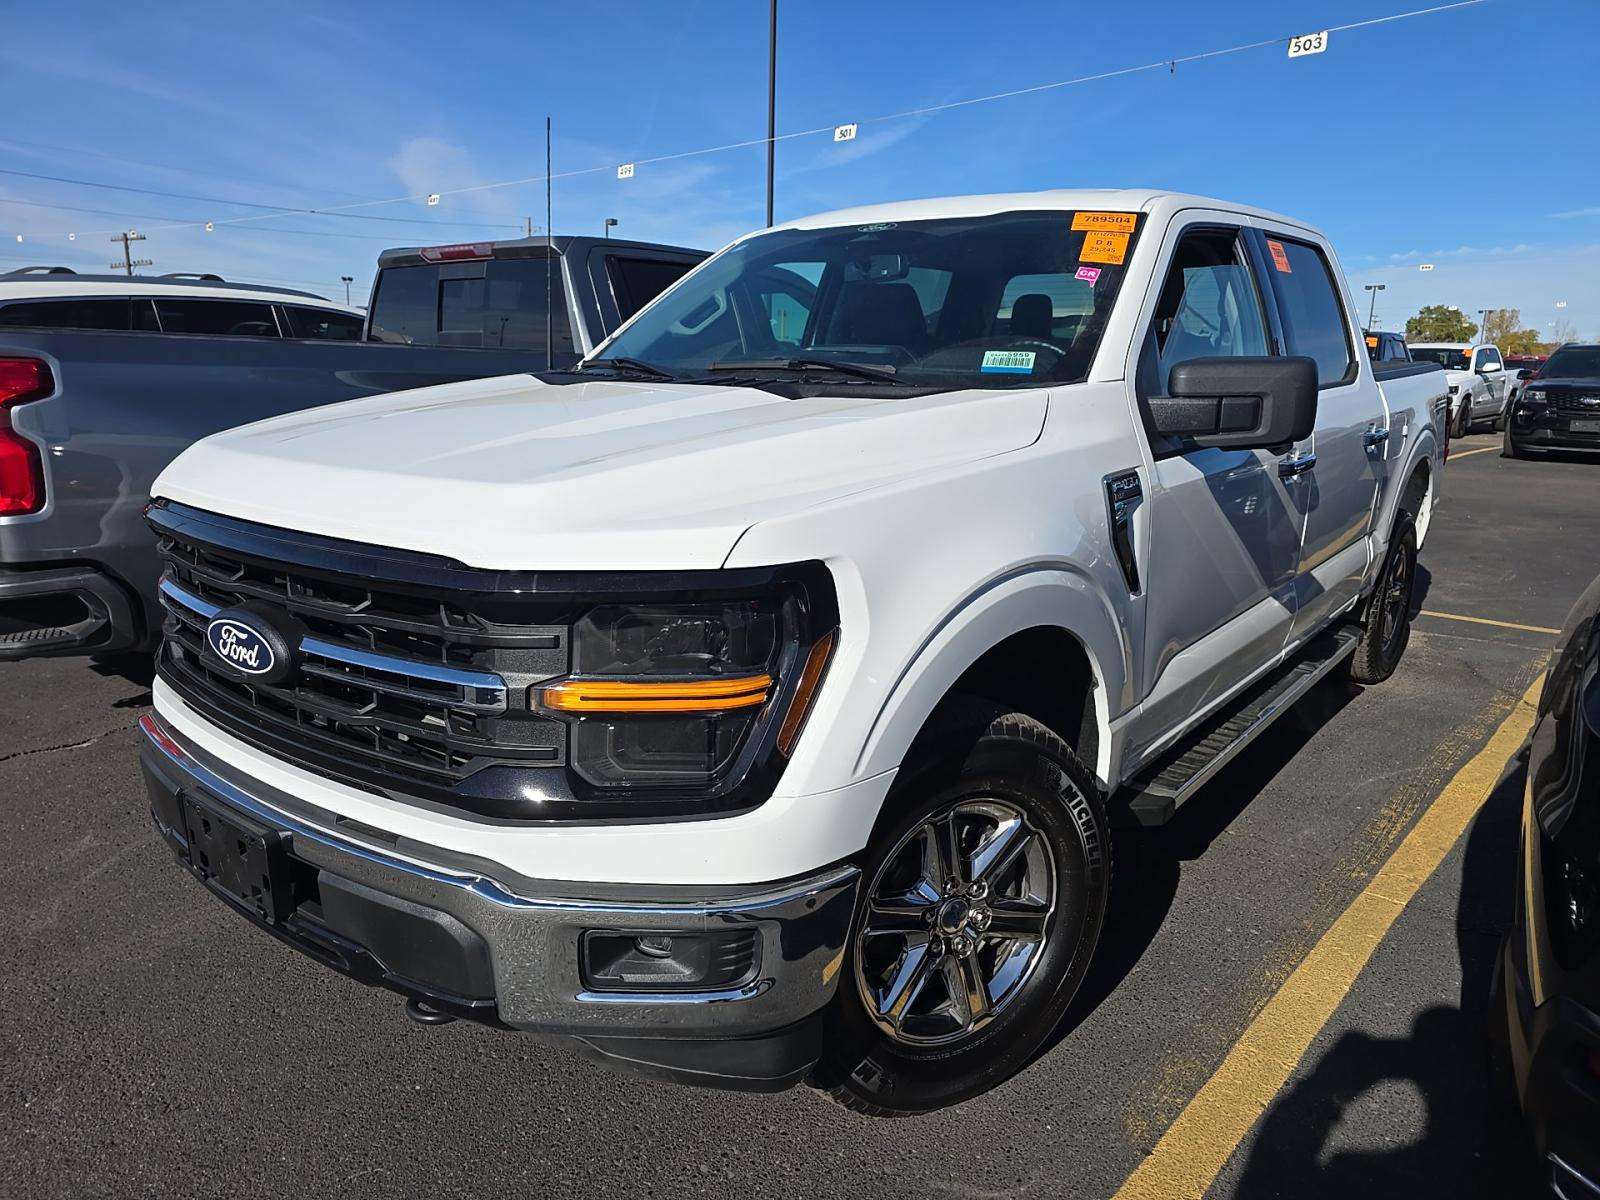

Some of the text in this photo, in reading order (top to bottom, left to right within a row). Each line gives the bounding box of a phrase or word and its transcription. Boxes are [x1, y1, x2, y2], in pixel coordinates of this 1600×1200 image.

[1293, 36, 1322, 53] 503
[838, 128, 852, 139] 501
[1084, 215, 1131, 224] 789504
[1080, 269, 1097, 277] CR
[219, 625, 260, 668] Ford
[1060, 784, 1101, 881] MICHELI
